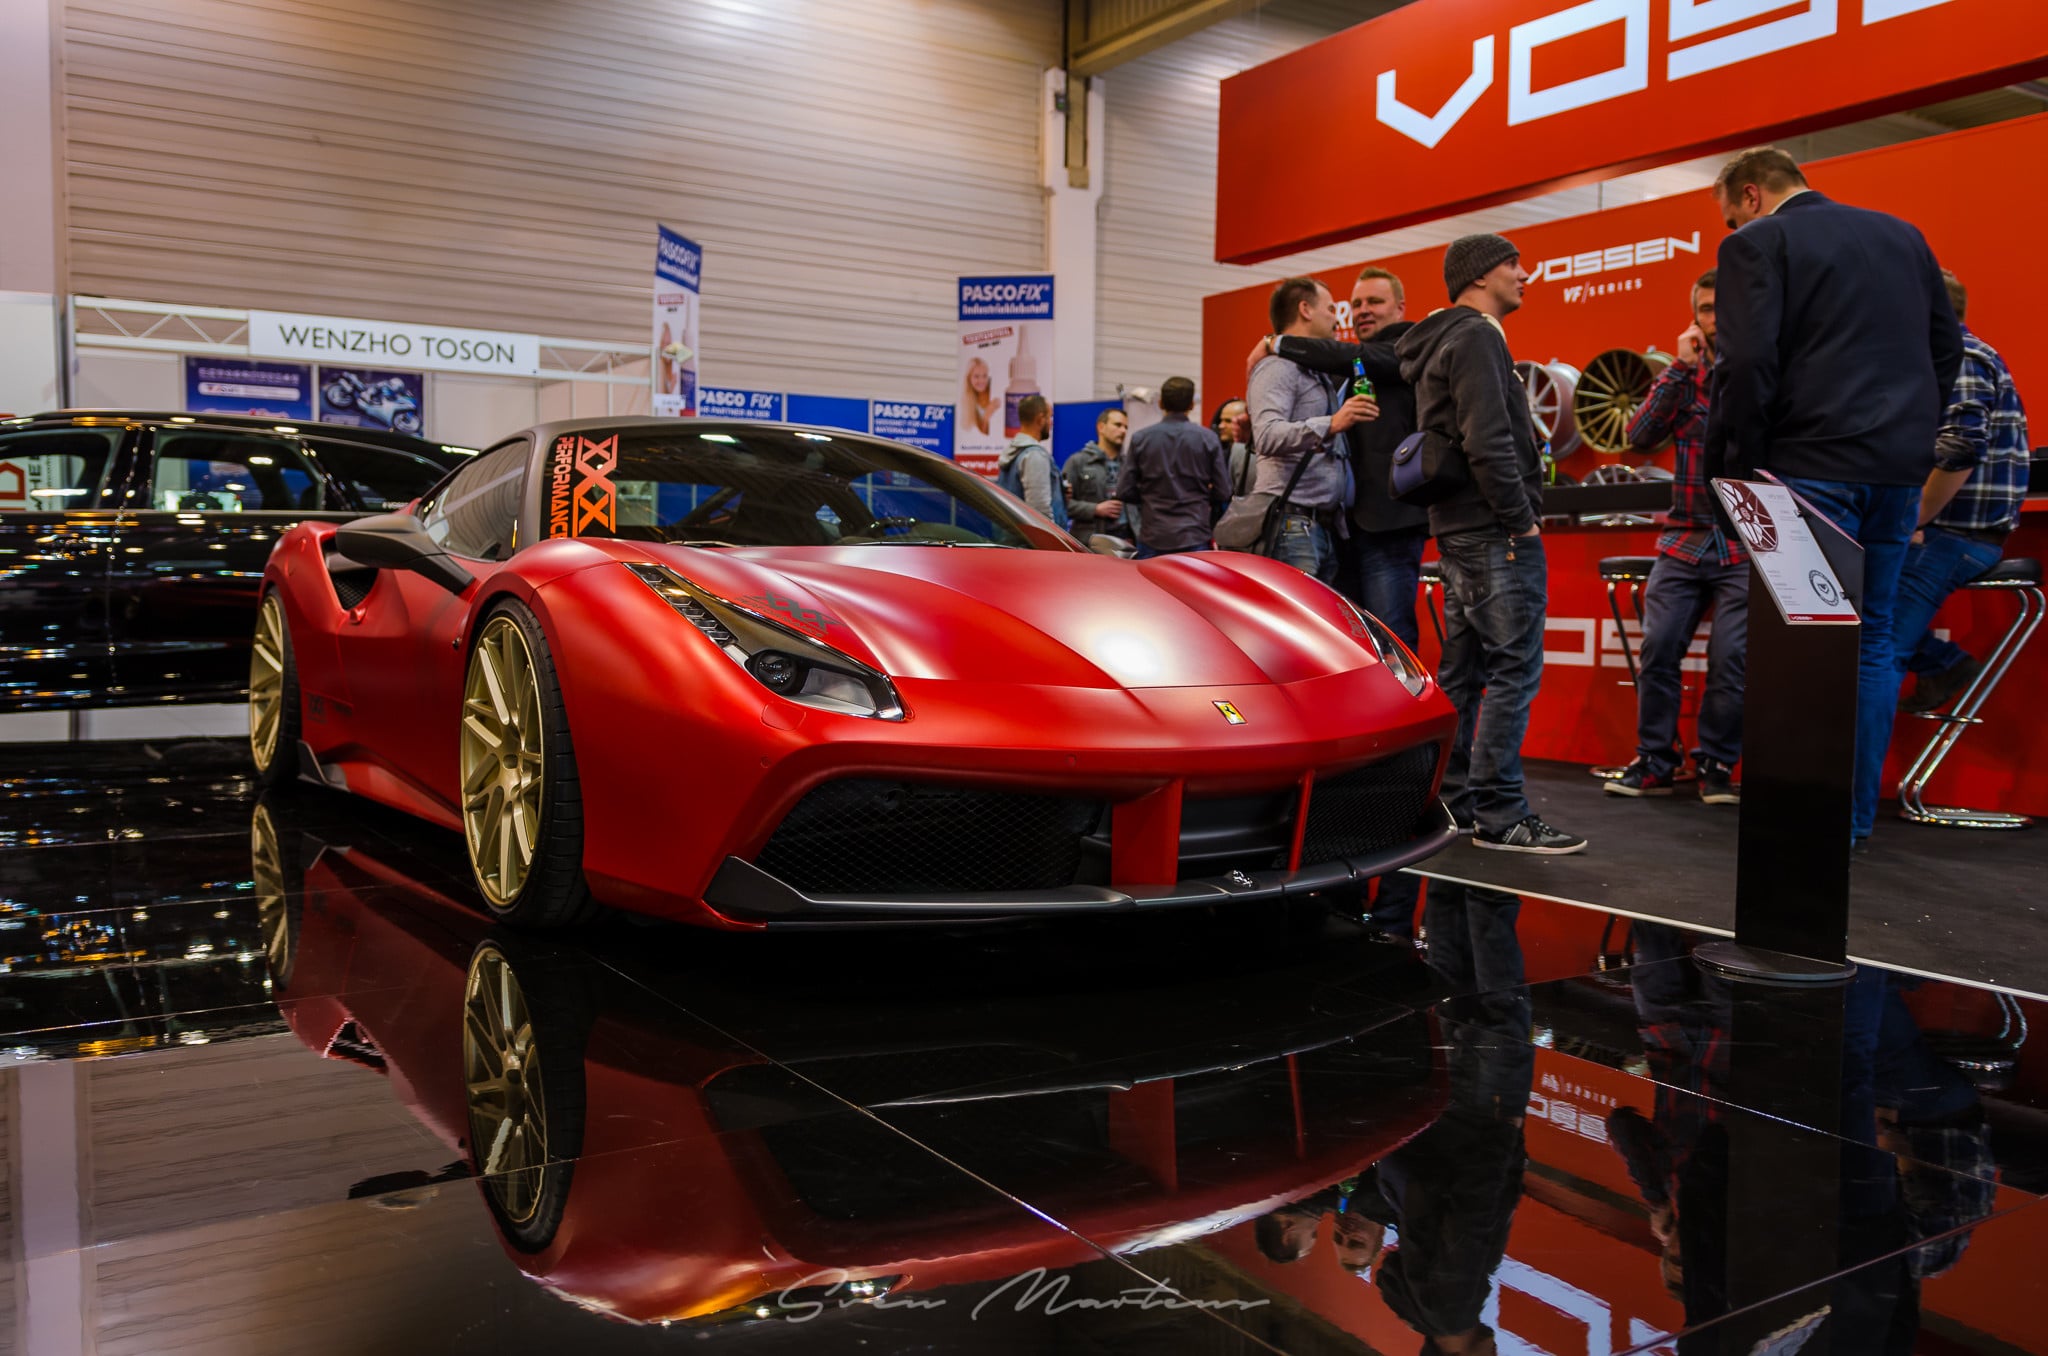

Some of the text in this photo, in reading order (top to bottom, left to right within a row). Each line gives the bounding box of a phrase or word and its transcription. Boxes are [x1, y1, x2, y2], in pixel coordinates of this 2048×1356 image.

[279, 323, 515, 364] WENZHO TOSON
[697, 389, 746, 408] PASCO
[874, 403, 921, 420] PASCO
